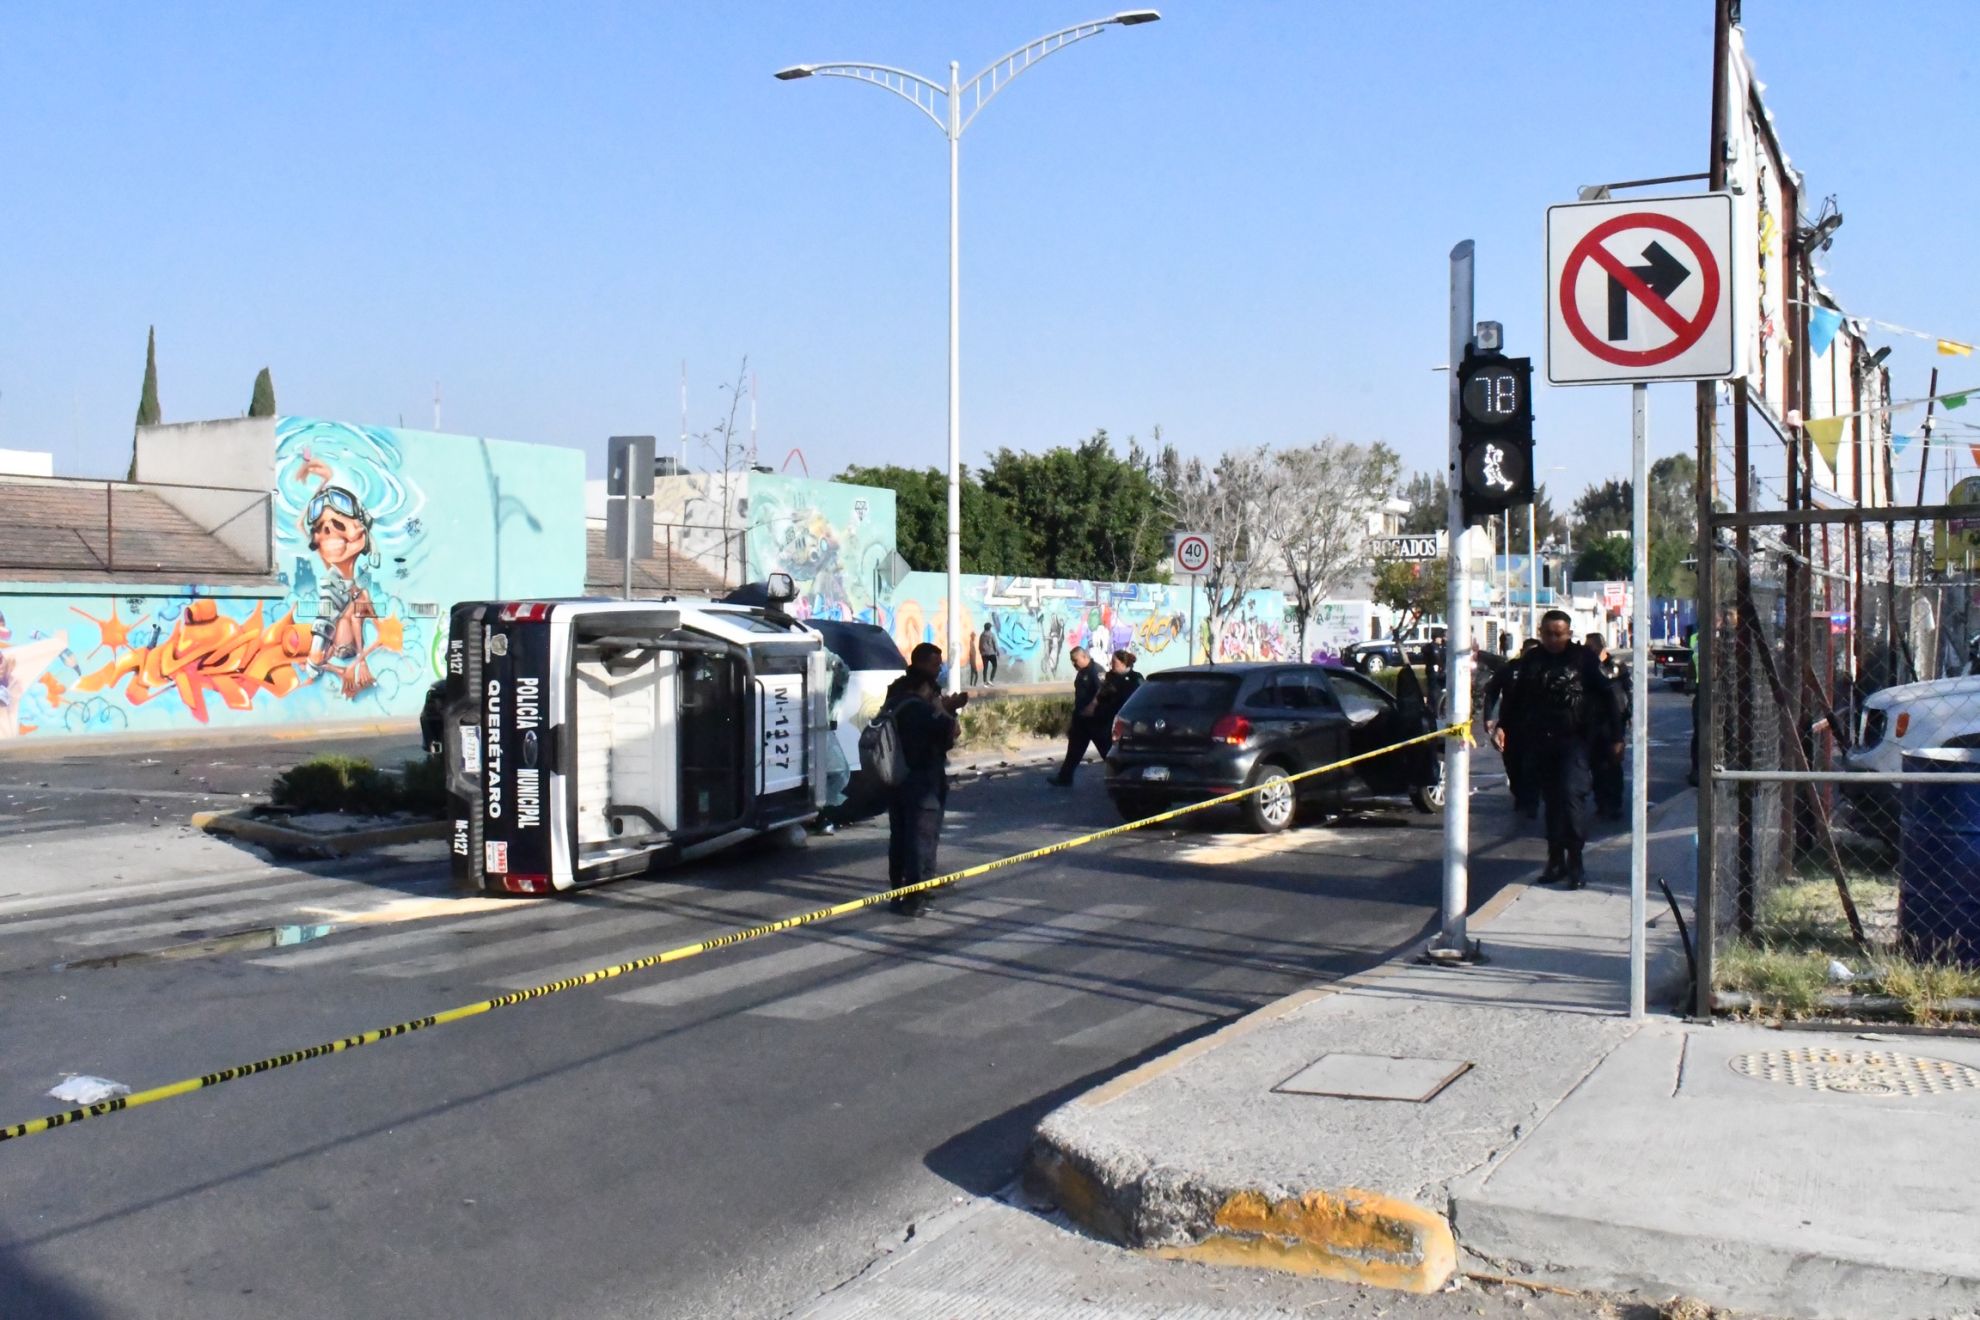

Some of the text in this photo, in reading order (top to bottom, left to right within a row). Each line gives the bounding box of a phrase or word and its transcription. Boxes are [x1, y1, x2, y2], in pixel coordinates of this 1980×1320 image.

[1475, 375, 1515, 413] 78
[1185, 543, 1202, 557] 40
[1371, 538, 1437, 557] BOGADOS
[450, 639, 463, 675] M-1127
[488, 680, 504, 818] QUERÉTARO
[516, 677, 543, 829] POLICÍA MUNICIPAL
[453, 819, 469, 856] M-1127
